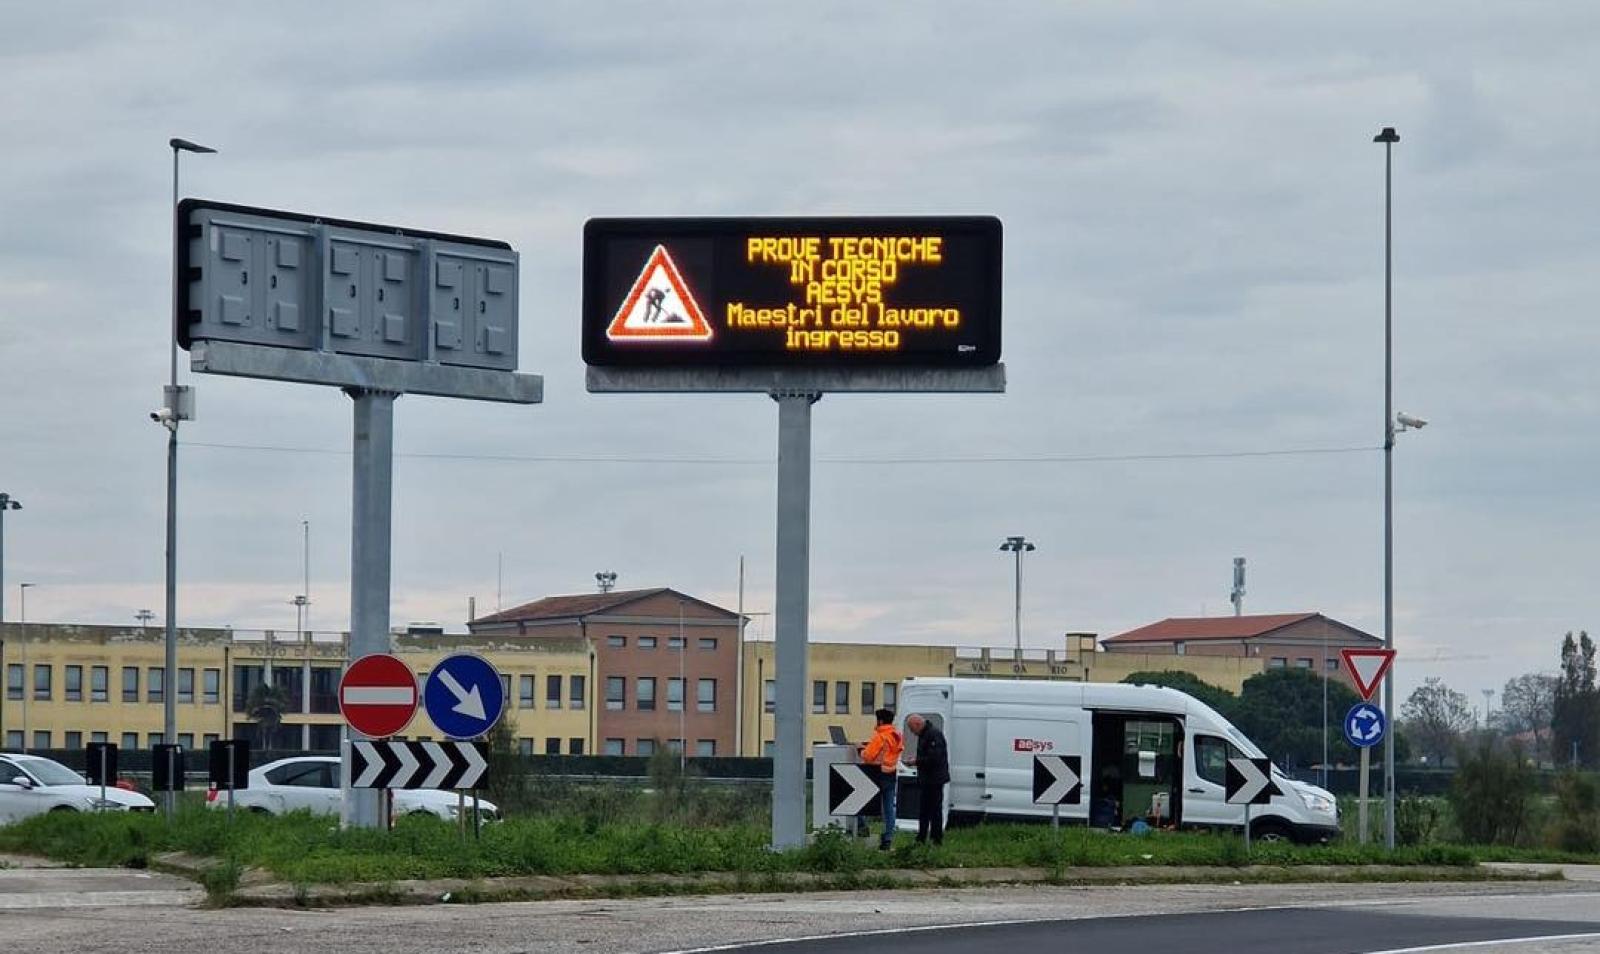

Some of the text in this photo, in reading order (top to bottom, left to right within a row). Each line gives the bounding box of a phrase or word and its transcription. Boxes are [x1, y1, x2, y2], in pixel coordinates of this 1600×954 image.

[747, 237, 942, 261] PROVE TECNICHE
[790, 260, 897, 283] IN CORSO
[806, 281, 882, 304] AESYS
[727, 302, 960, 327] Maestri del lavoro
[786, 326, 899, 348] ingresso
[1014, 739, 1053, 752] aesys
